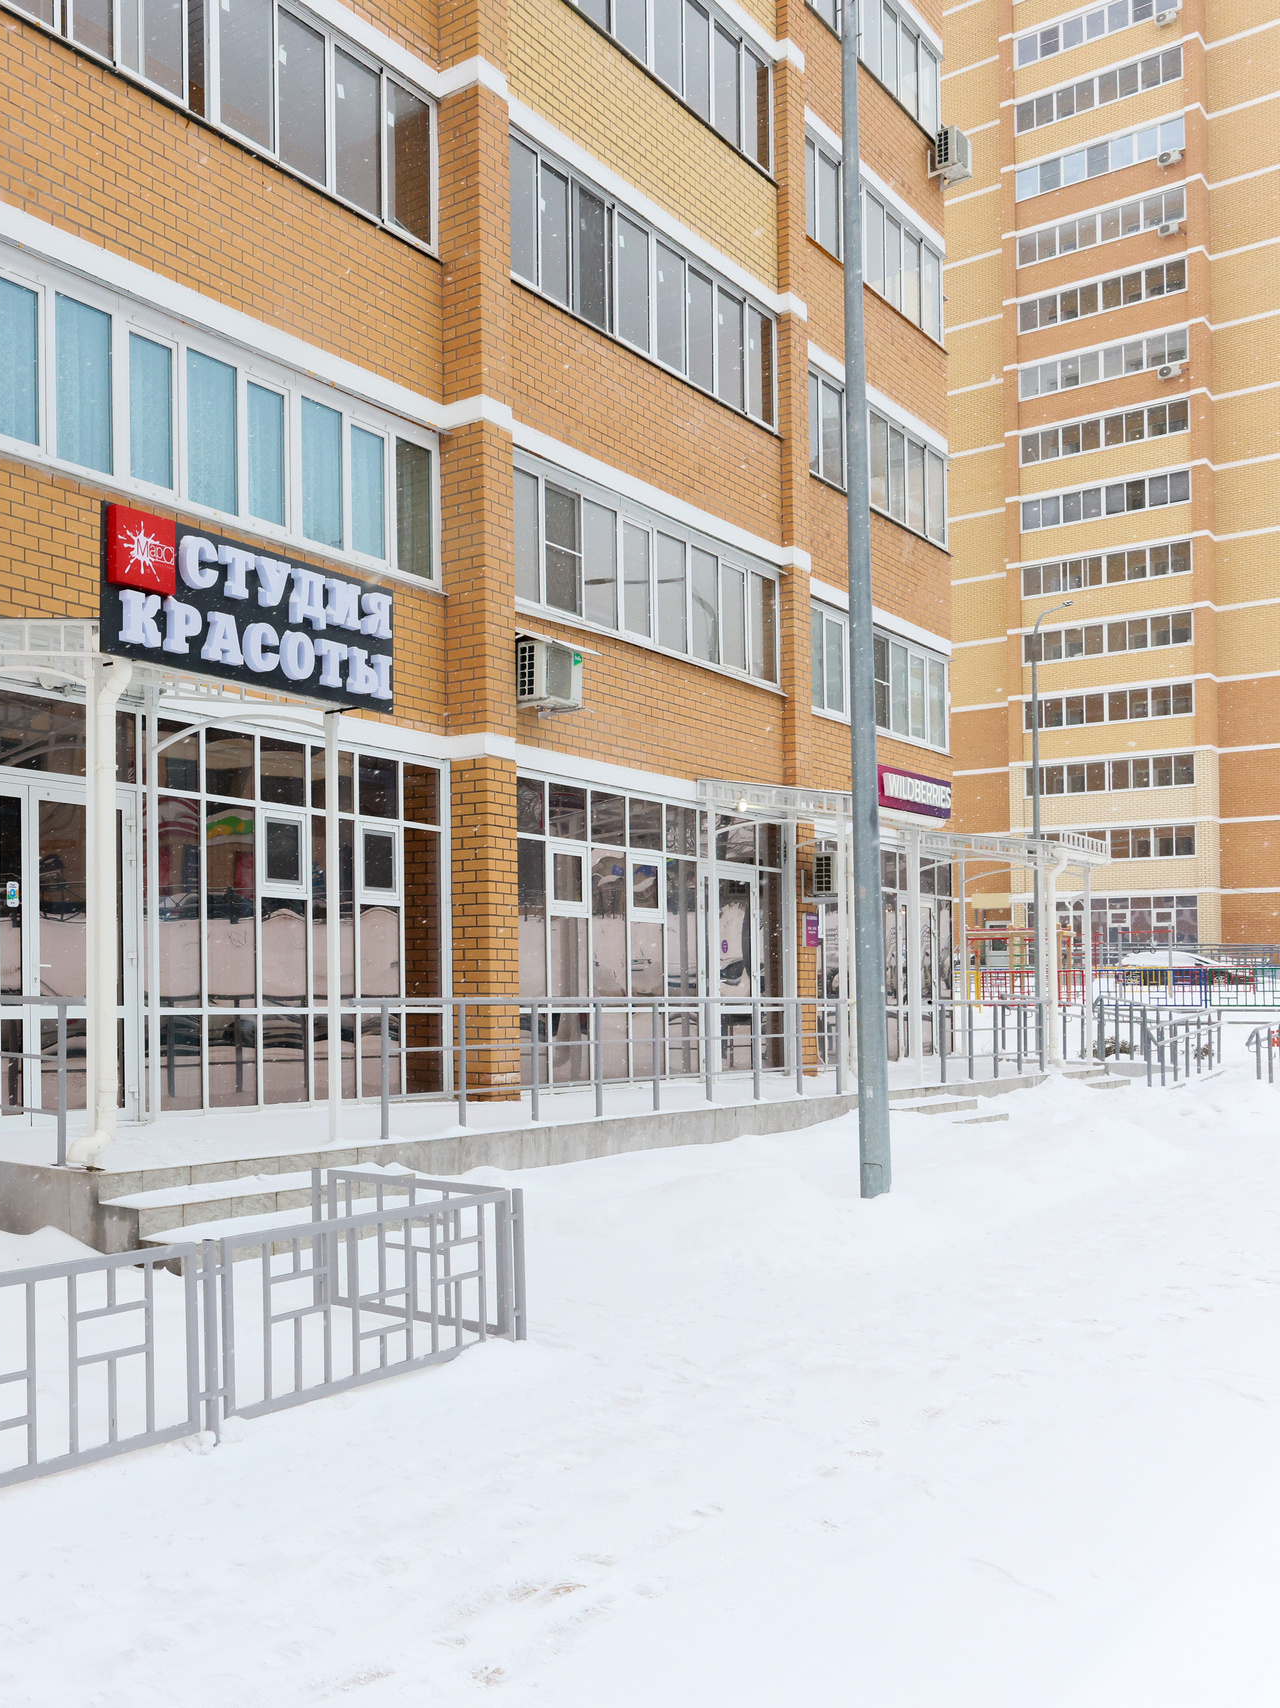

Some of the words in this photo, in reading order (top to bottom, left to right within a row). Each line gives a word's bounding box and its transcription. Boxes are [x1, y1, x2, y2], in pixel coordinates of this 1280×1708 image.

[179, 535, 392, 639] СТУДИЯ
[119, 589, 392, 700] КРАСОТЫ
[883, 772, 952, 809] WILDBERRIES
